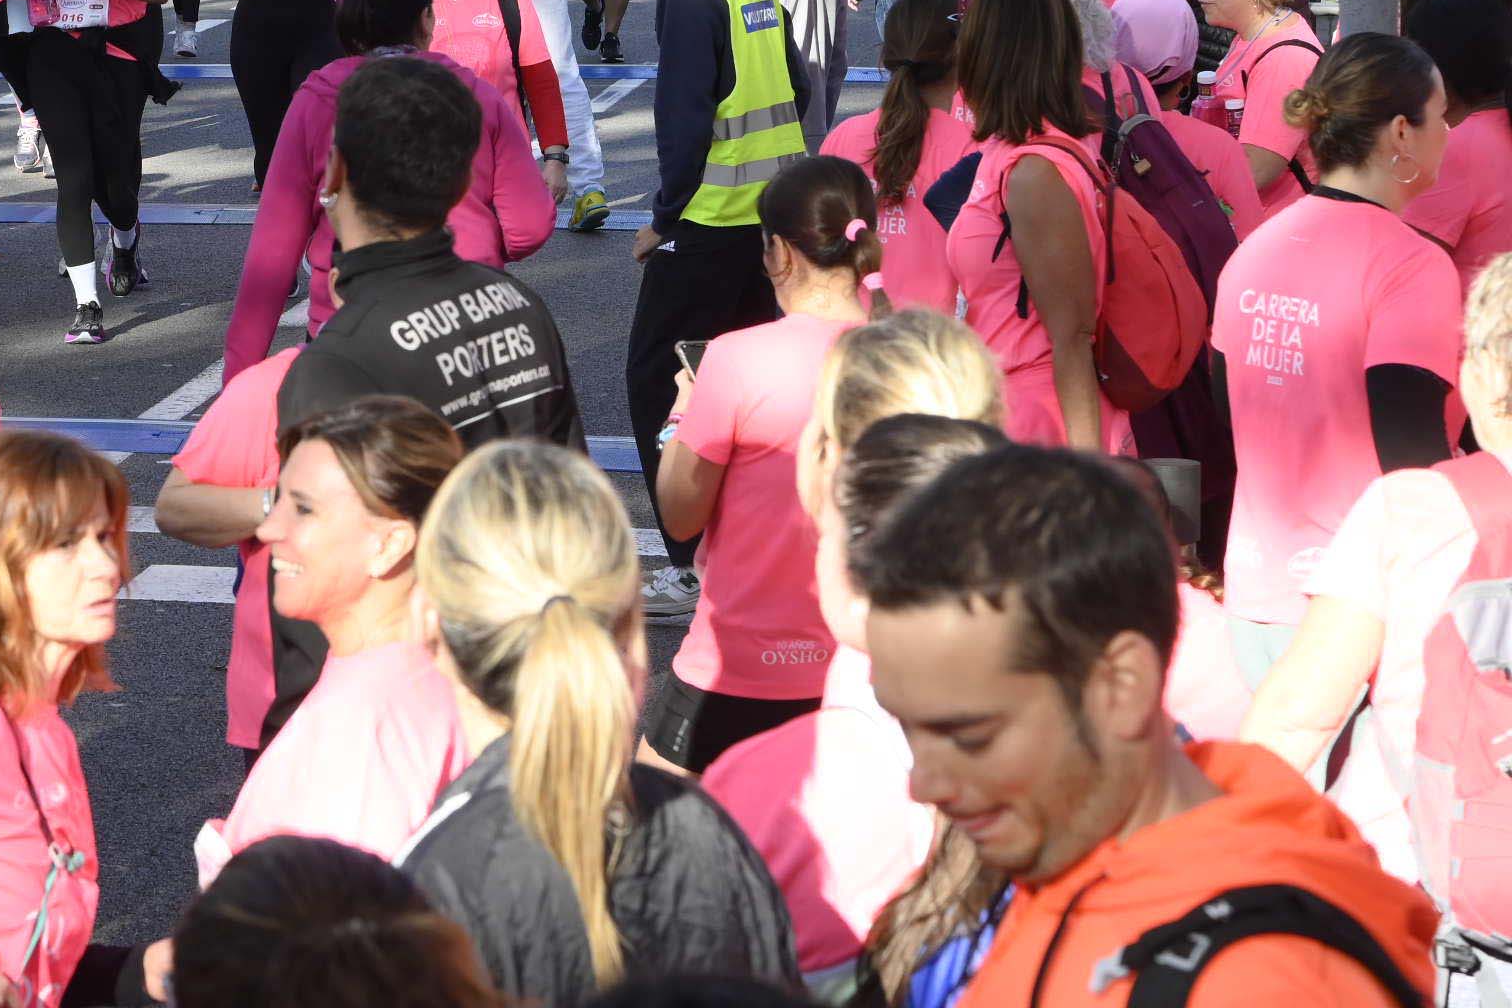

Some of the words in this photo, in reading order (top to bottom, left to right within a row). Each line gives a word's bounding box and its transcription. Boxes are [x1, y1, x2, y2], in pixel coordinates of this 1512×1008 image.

[61, 13, 84, 23] 016
[389, 299, 461, 351] GRUP
[458, 281, 531, 323] BARNA
[1239, 288, 1320, 328] CARRERA
[1251, 316, 1277, 346] DE
[1279, 318, 1303, 349] LA
[435, 322, 536, 387] PORTERS
[1245, 344, 1305, 376] MUJER
[761, 648, 829, 665] OYSHO
